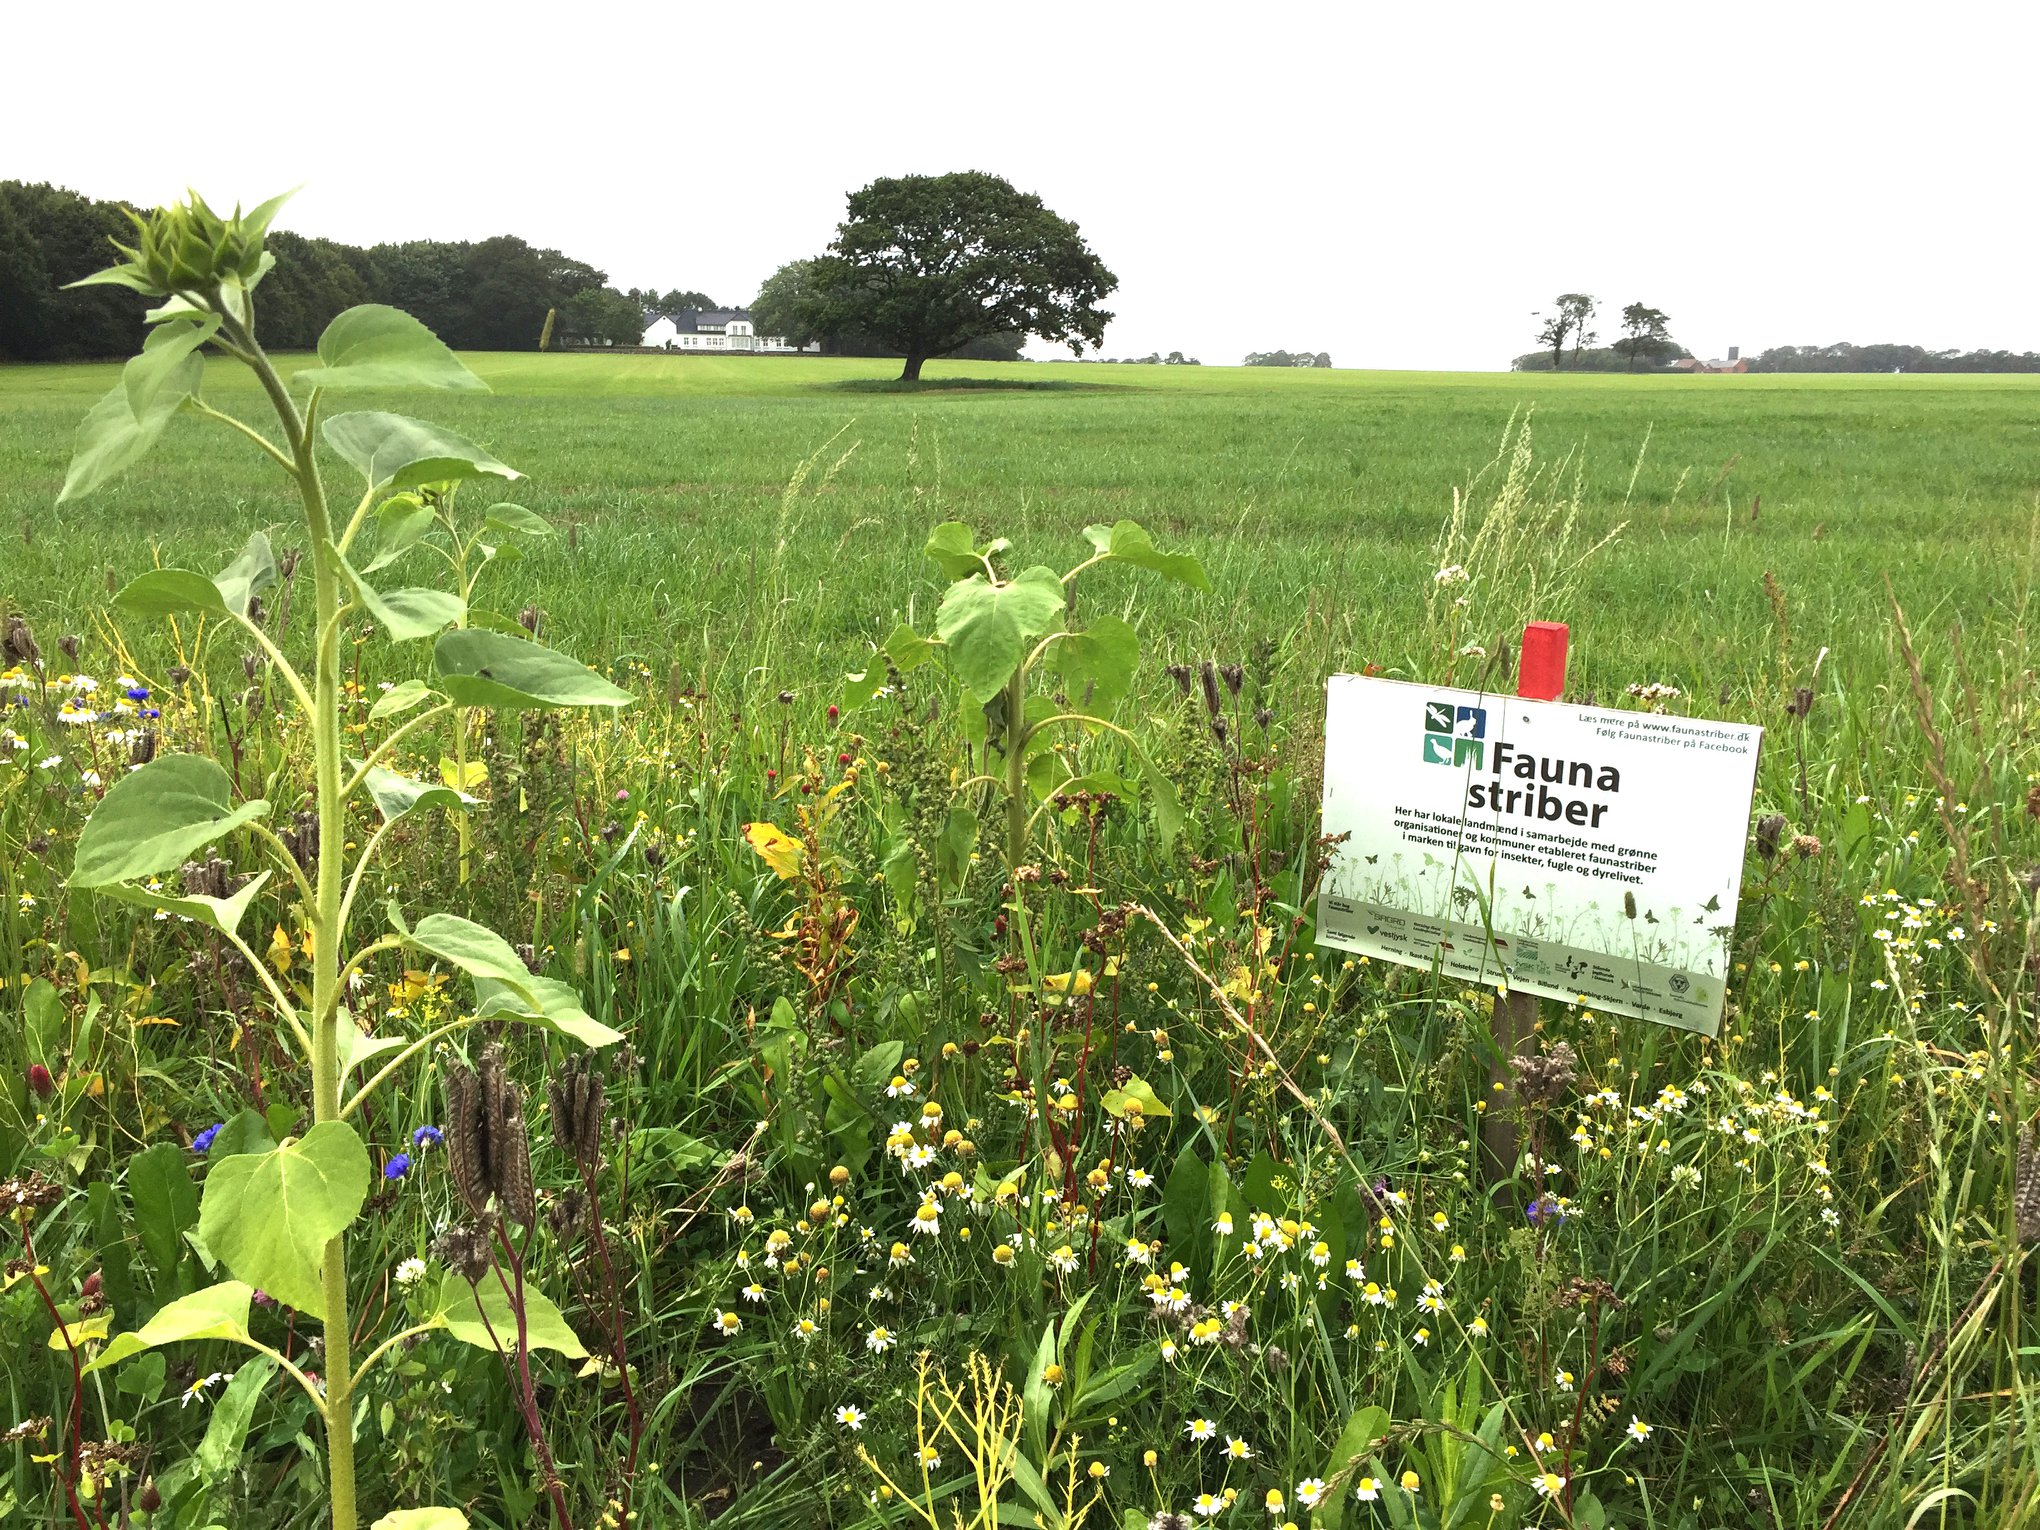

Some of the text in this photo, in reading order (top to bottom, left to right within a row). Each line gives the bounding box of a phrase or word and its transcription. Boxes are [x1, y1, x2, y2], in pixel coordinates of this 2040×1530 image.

[1579, 713, 1751, 743] Læs mere på www.faunastriber.dk
[1596, 727, 1749, 755] Følg Faunastriber på Facebook
[1492, 742, 1621, 793] Fauna
[1468, 781, 1609, 829] striber
[1394, 805, 1659, 861] Her har lokale landmænd i samarbejde med grønne
[1465, 831, 1478, 844] og
[1479, 833, 1536, 853] kommuner
[1537, 843, 1587, 862] etableret
[1588, 853, 1658, 874] faunastriber
[1402, 831, 1645, 886] i marken til gavn for insekter, fugle og dyrelivet.
[1379, 930, 1409, 943] vestjysk
[1380, 945, 1403, 957] Herning
[1450, 960, 1480, 973] Holstebro
[1486, 968, 1503, 978] Strue
[1512, 974, 1531, 985] Vejen
[1537, 980, 1560, 991] Billund
[1566, 986, 1624, 1005] Ringkøbing-Skjern
[1631, 1000, 1651, 1011] Varde
[1658, 1007, 1684, 1020] Esbjerg
